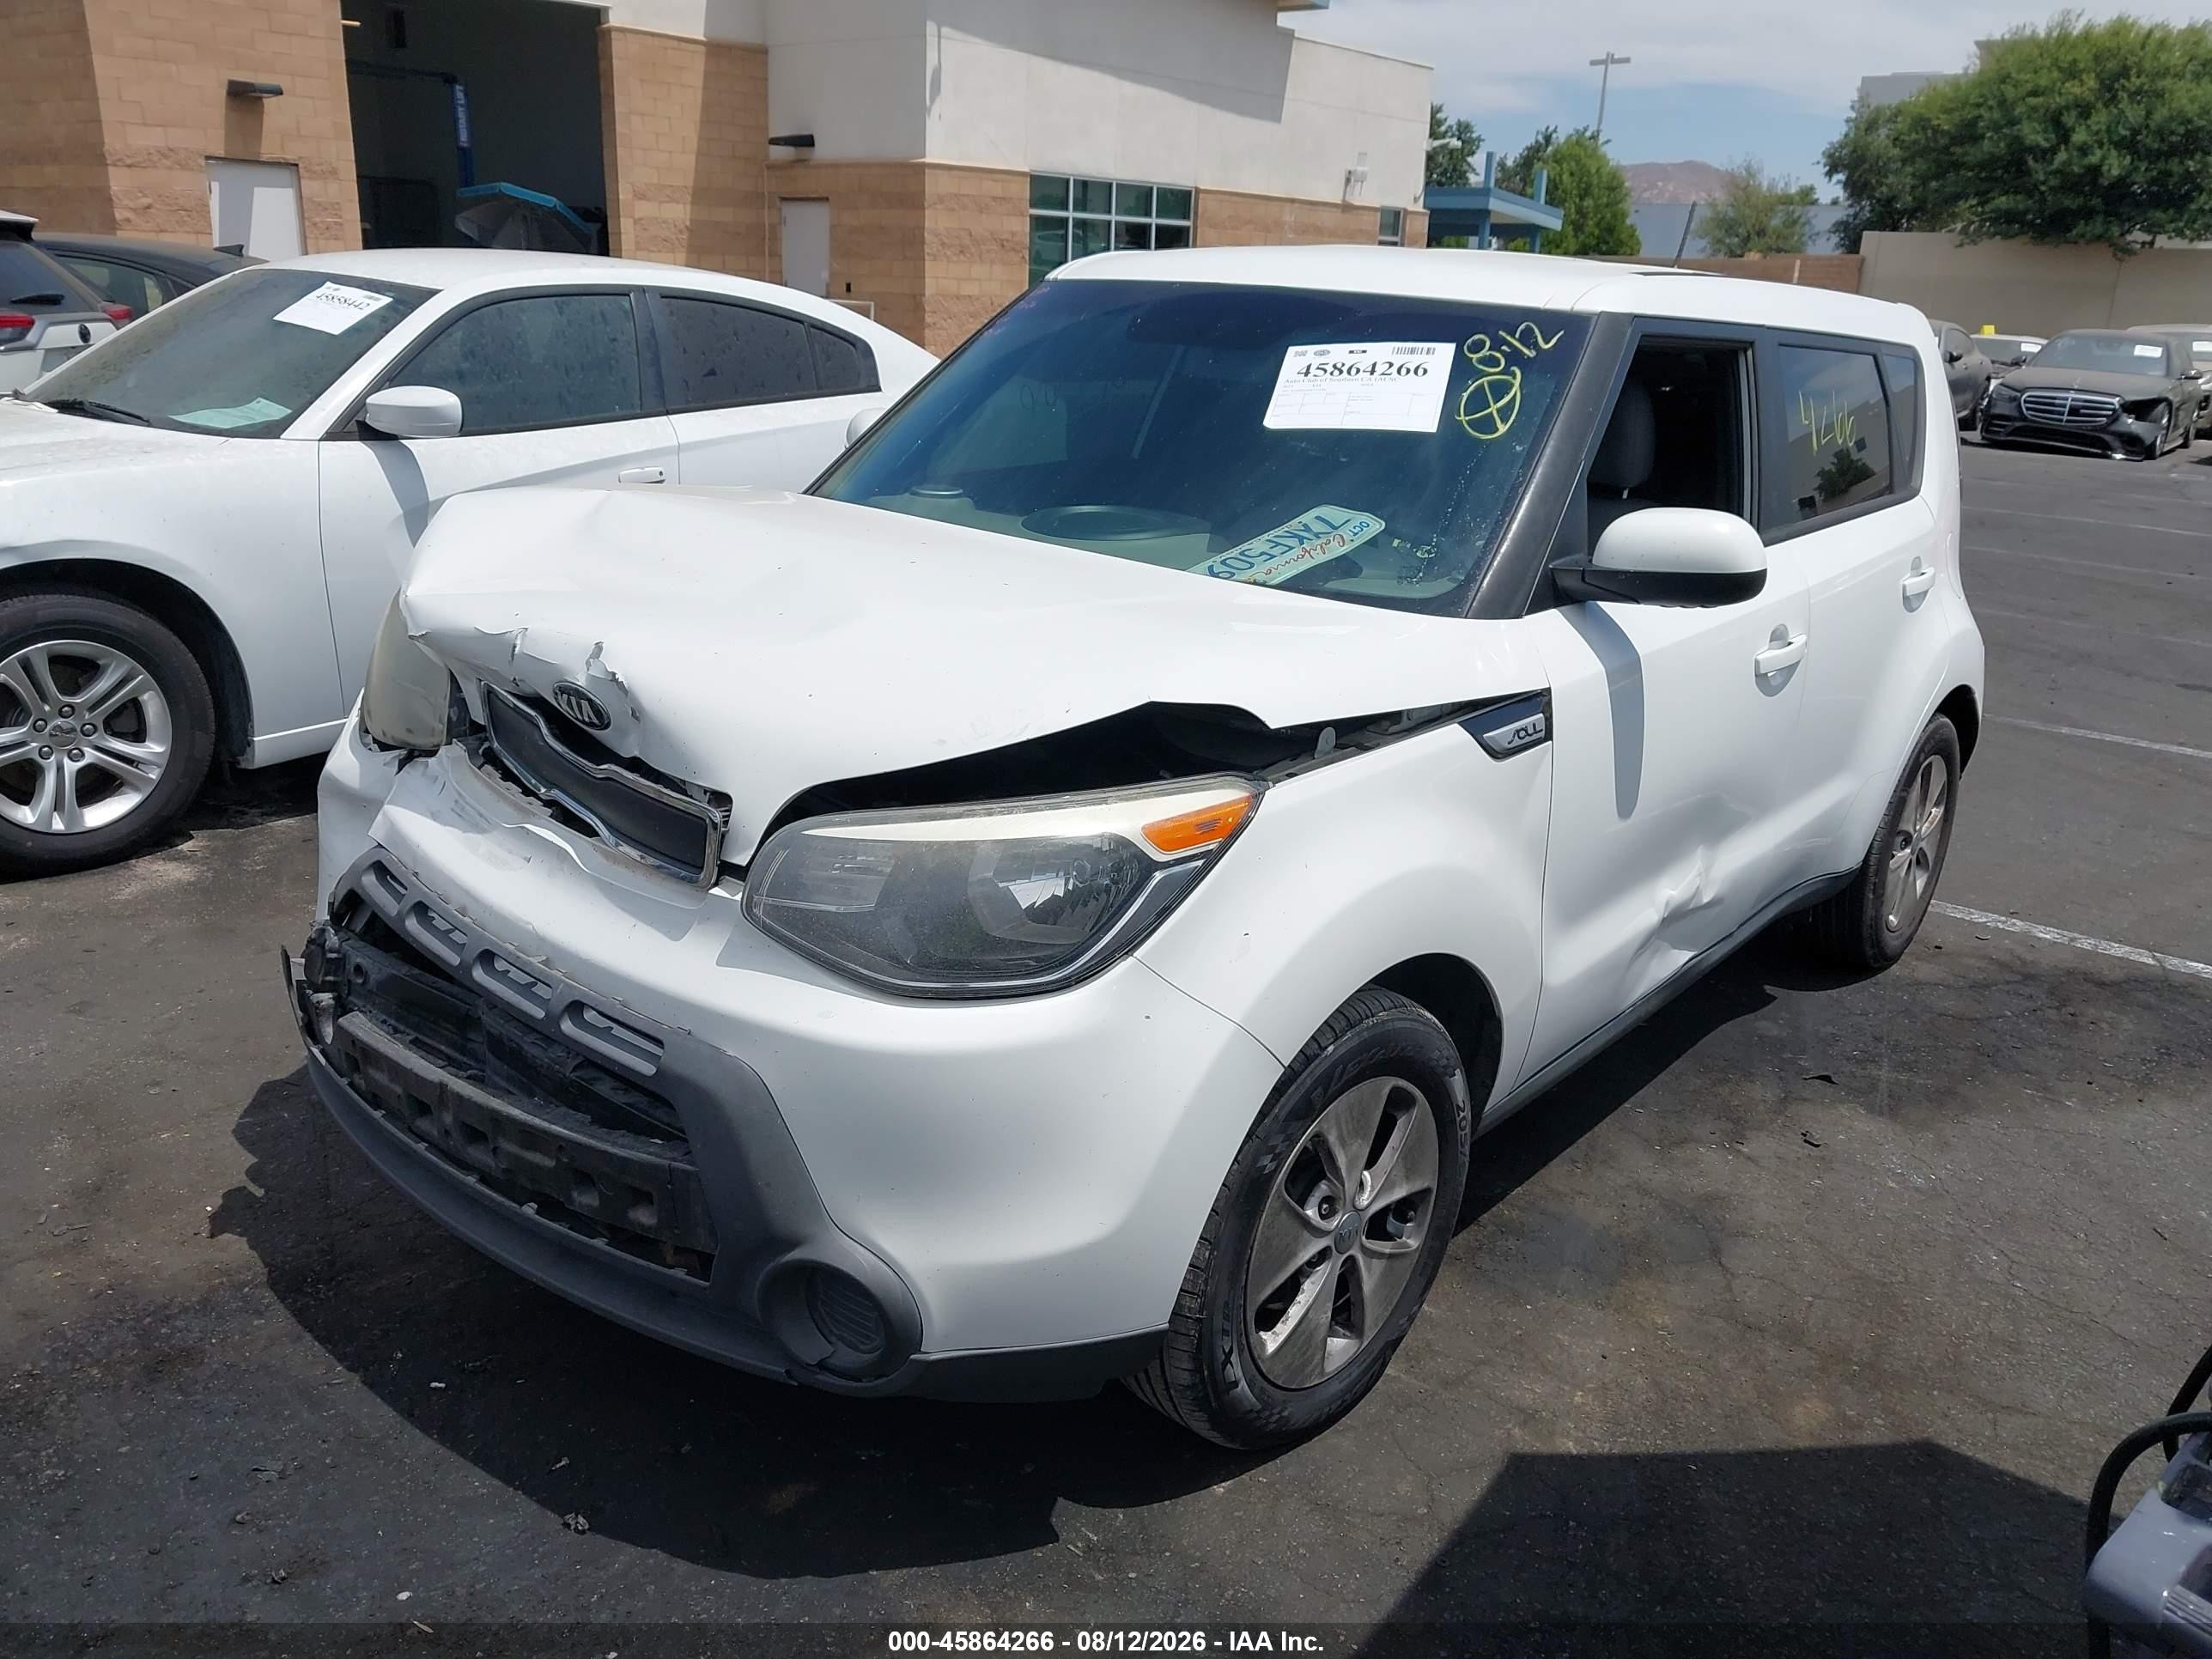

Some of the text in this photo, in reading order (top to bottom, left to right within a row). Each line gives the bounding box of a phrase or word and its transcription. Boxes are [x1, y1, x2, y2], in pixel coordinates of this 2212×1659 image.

[1297, 361, 1428, 377] 45864266
[1348, 520, 1370, 538] OCT
[1255, 533, 1346, 576] California
[554, 688, 602, 725] KIA
[1507, 722, 1544, 745] SOUL
